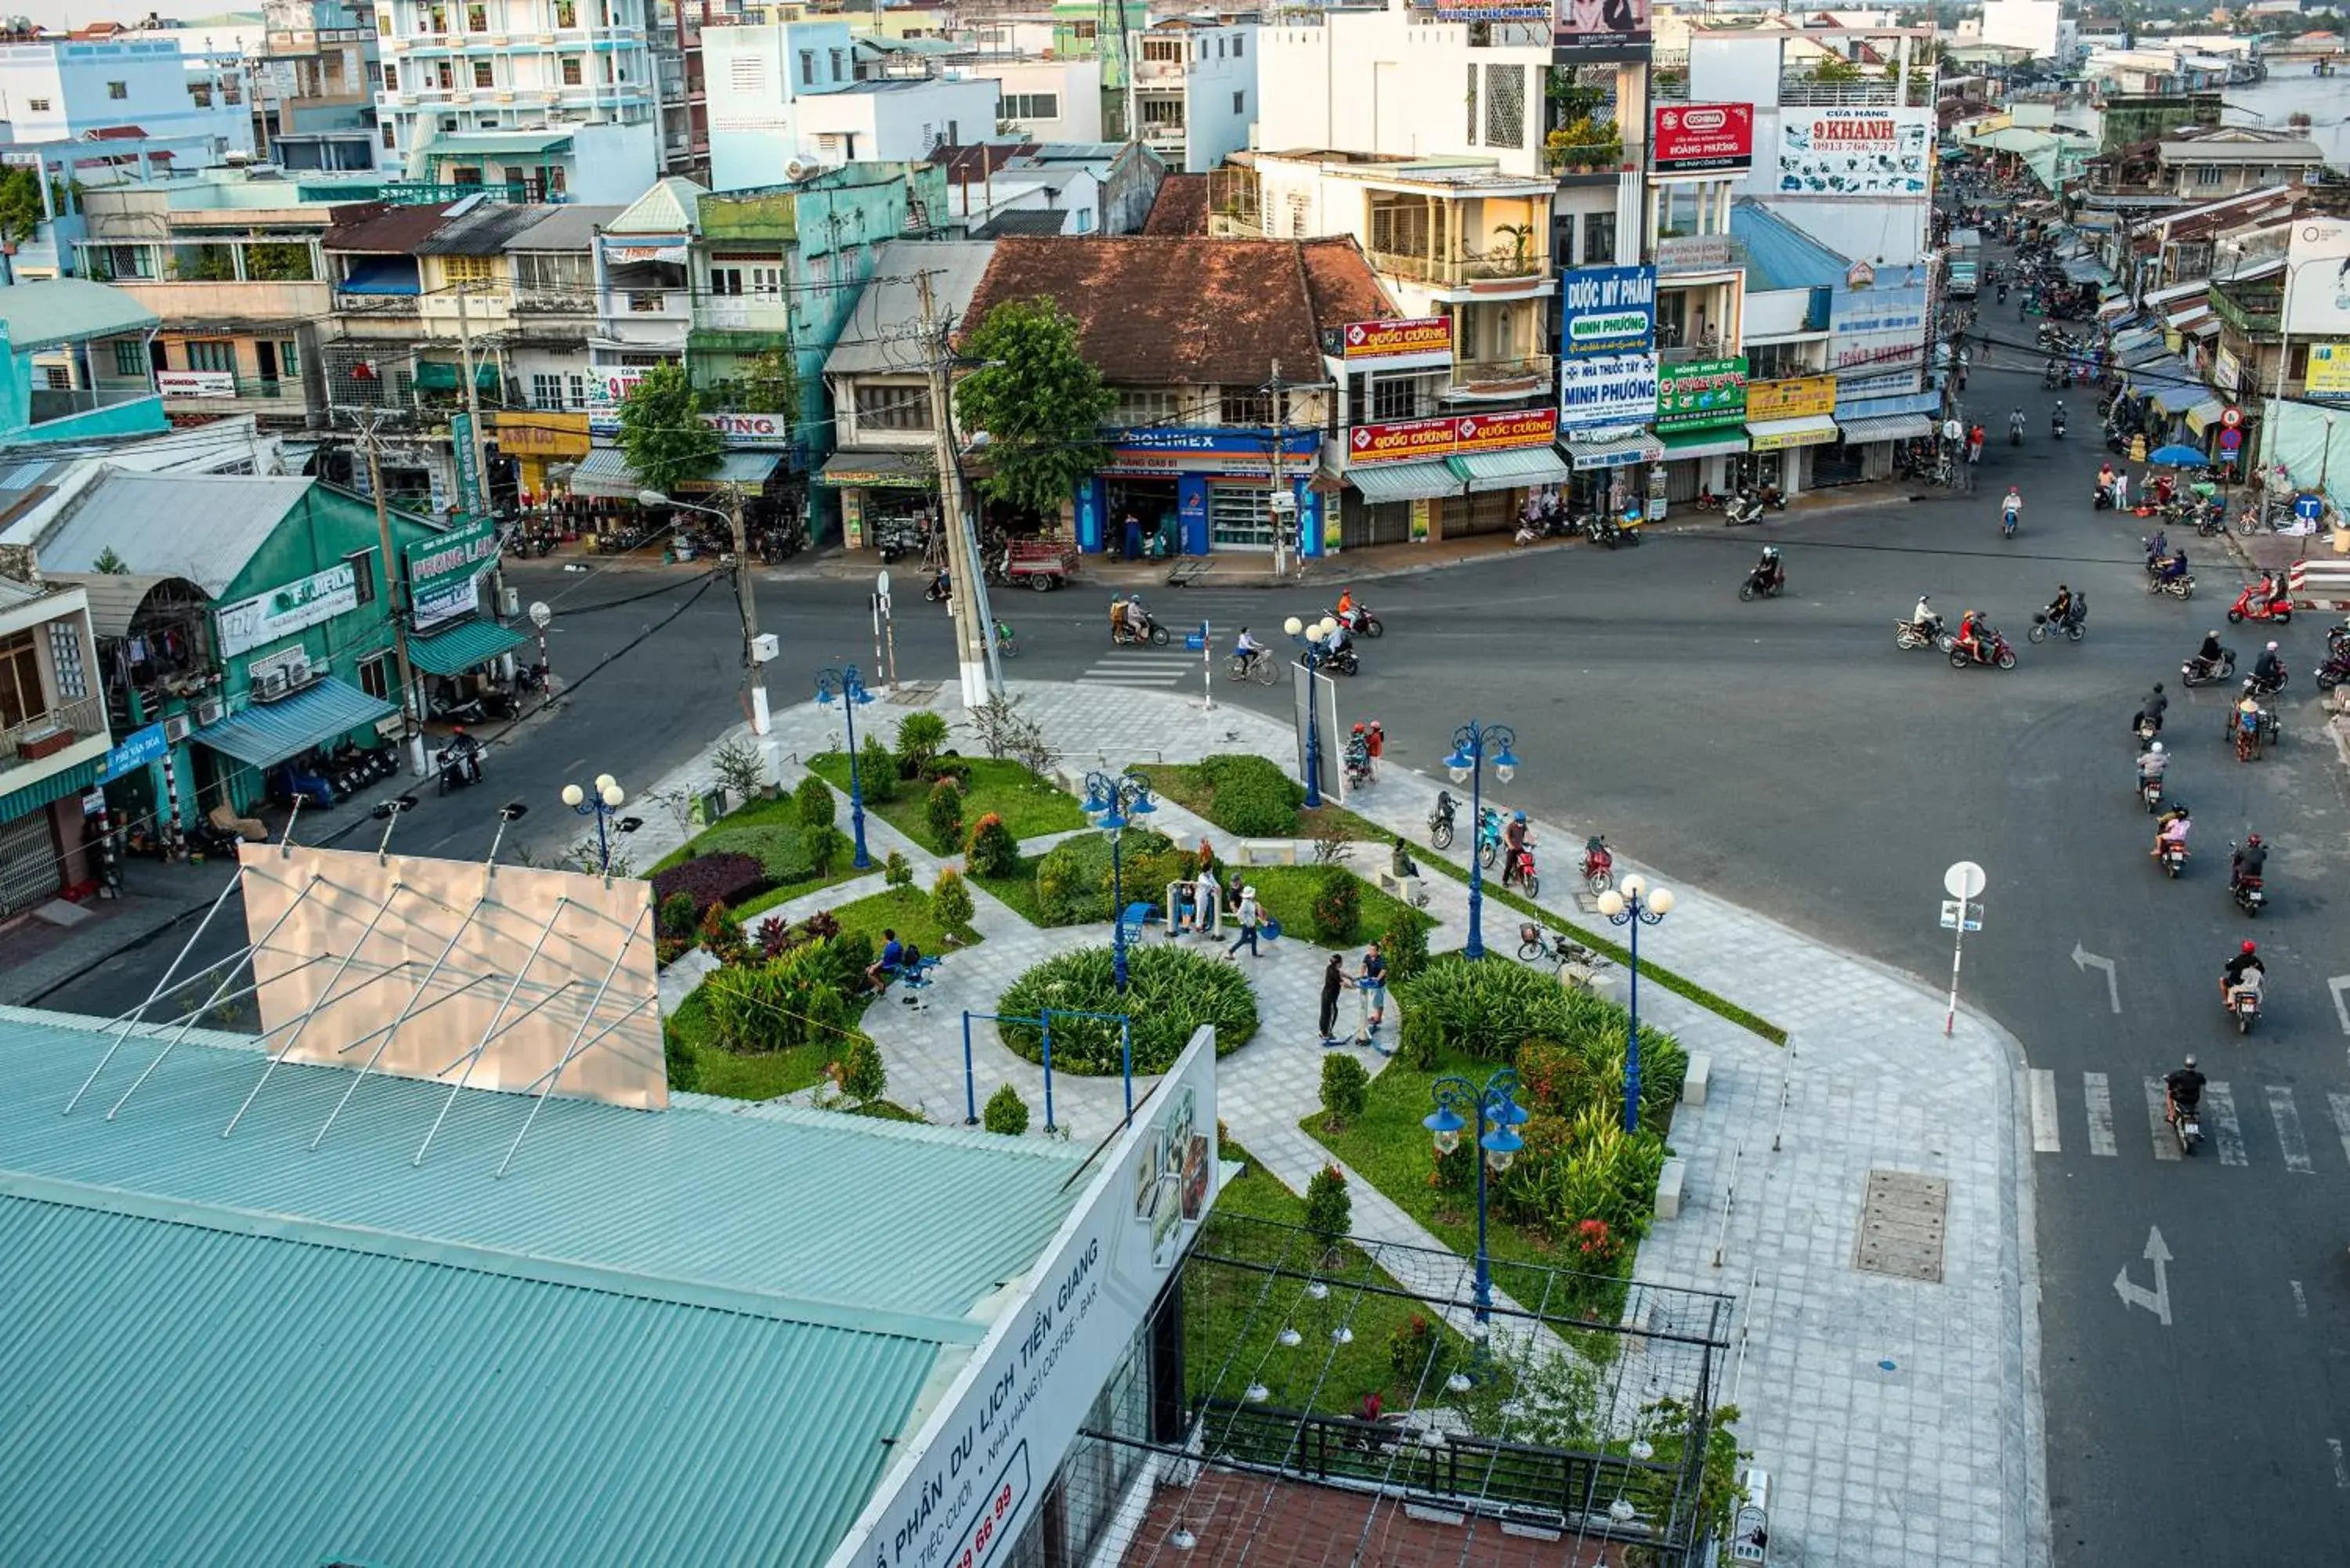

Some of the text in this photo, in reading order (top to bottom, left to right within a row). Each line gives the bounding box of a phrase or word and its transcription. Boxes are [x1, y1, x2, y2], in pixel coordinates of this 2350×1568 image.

[1813, 120, 1896, 140] 9 KHANH
[1567, 267, 1652, 315] DƯỢC MỸ PHẨM
[1367, 326, 1447, 346] QUỐC CƯỜNG
[1574, 315, 1646, 334] MINH PHƯƠNG
[1582, 359, 1640, 377] NHÀ THUỐC TÂY
[609, 377, 619, 399] 9
[1565, 378, 1656, 406] MINH PHƯƠNG
[1374, 426, 1454, 449] QUỐC CƯỜNG
[1477, 421, 1510, 439] QUỐC
[1513, 417, 1552, 434] CƯỜNG
[413, 546, 466, 581] PHONG
[950, 1425, 973, 1479] DU
[980, 1363, 1015, 1435] LỊCH
[1020, 1306, 1053, 1368] TIỀN
[1058, 1237, 1099, 1313] GIANG
[988, 1420, 1009, 1467] NHÀ
[1010, 1375, 1038, 1430] HÀNG
[1043, 1316, 1076, 1378] COFFEE
[1079, 1281, 1098, 1320] BAR
[975, 1516, 992, 1552] 66
[995, 1483, 1012, 1520] 99
